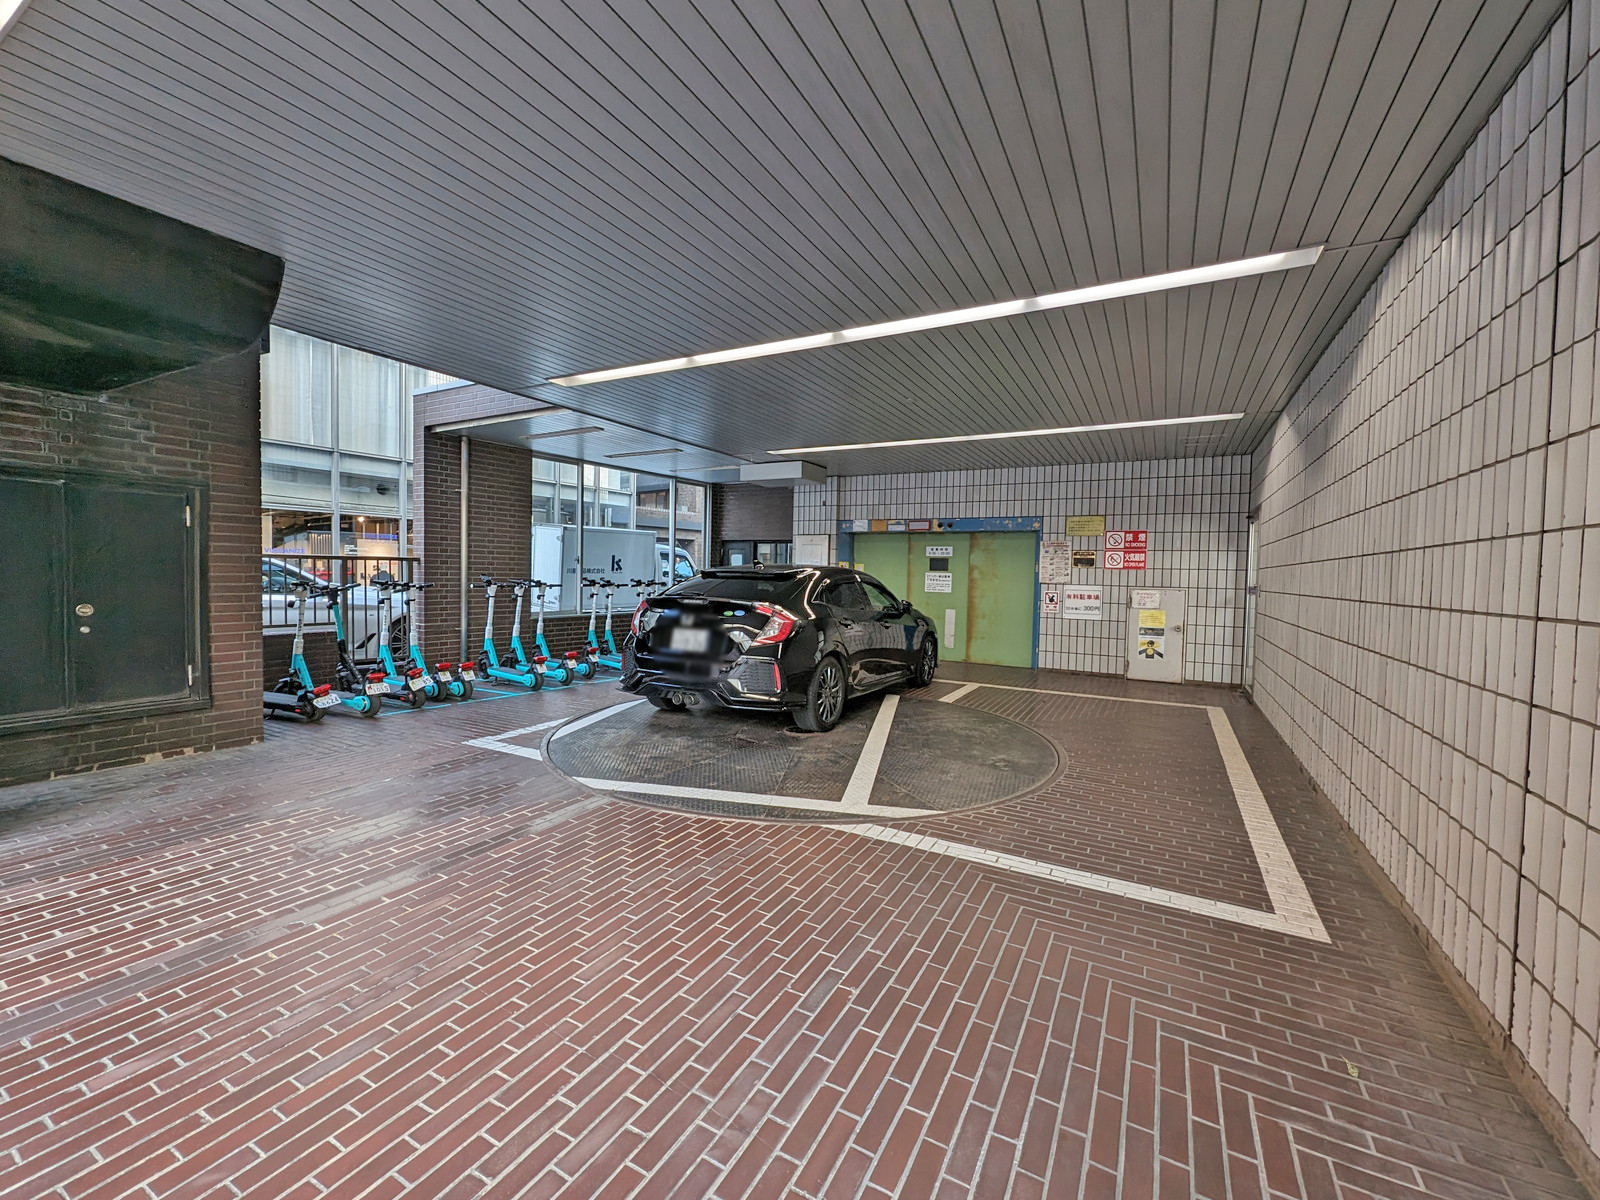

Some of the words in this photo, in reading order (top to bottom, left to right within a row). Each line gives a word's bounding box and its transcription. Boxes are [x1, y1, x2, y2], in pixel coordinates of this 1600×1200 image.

[1125, 533, 1146, 541] 禁煙
[1124, 552, 1145, 561] 火気厳禁
